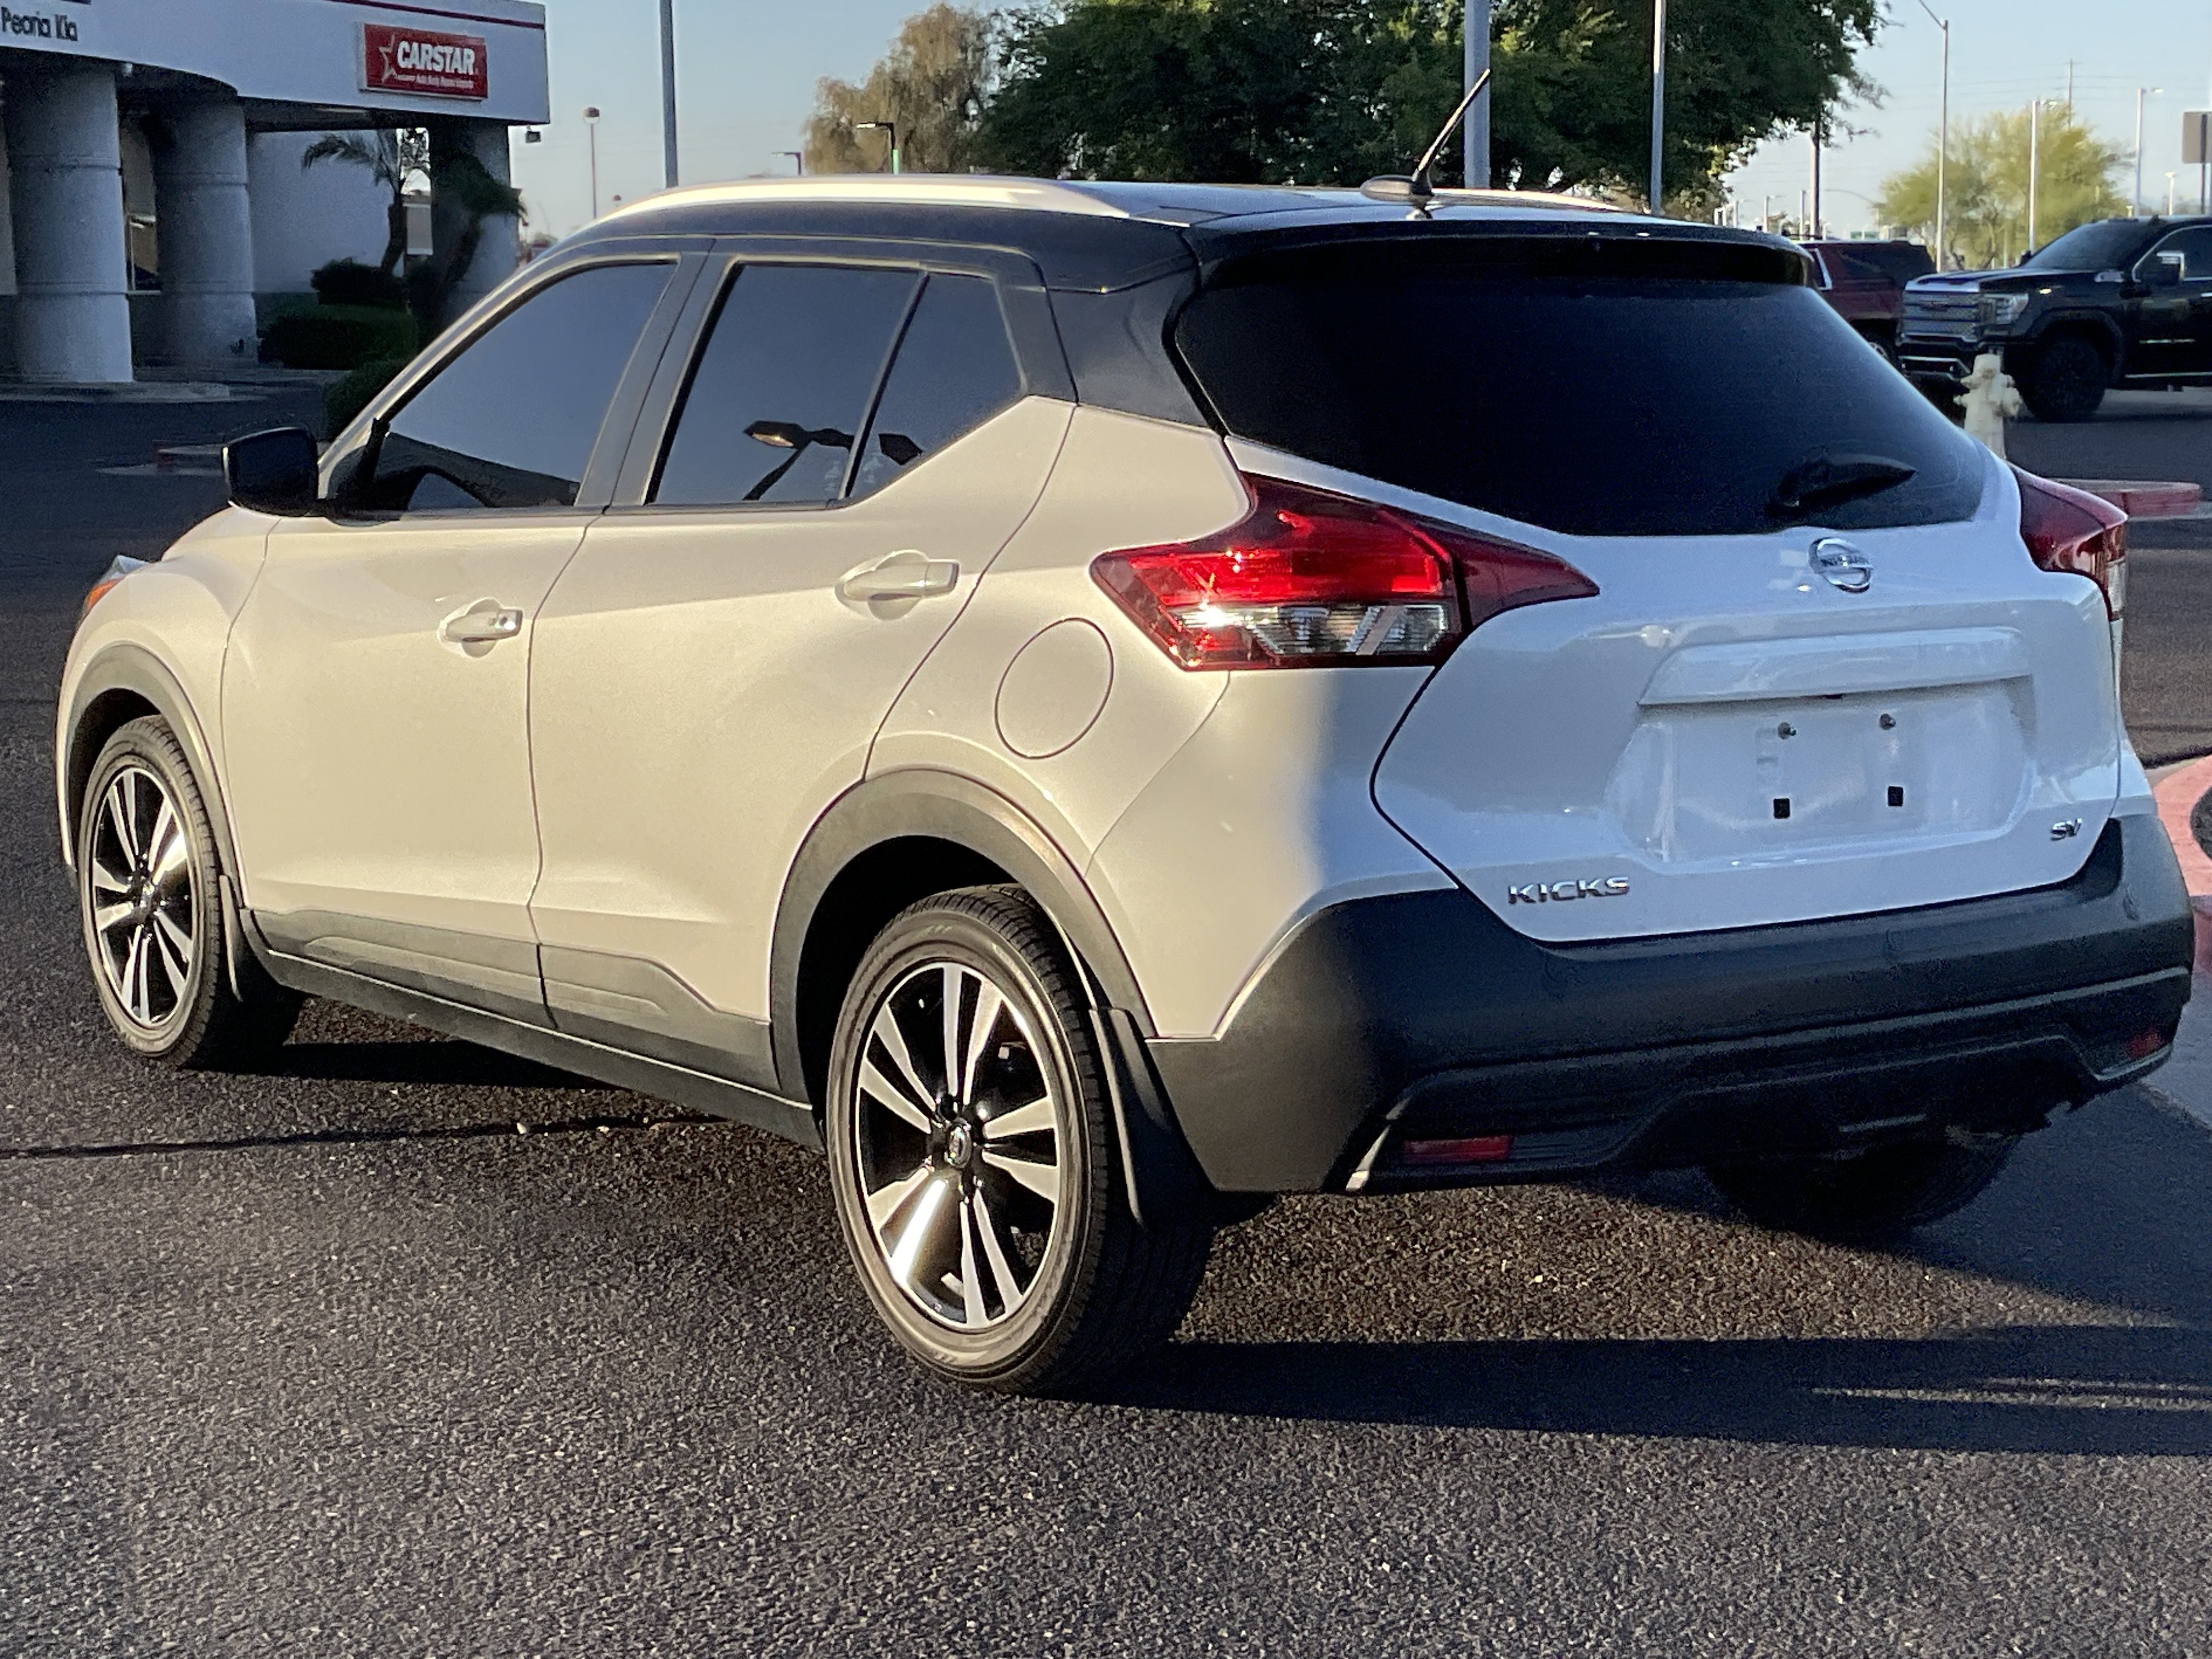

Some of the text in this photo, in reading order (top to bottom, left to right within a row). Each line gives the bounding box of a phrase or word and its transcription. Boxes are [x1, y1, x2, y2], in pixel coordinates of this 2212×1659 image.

[1, 7, 52, 38] Peoria
[397, 41, 476, 75] CARSTAR
[1508, 877, 1630, 904] KICKS
